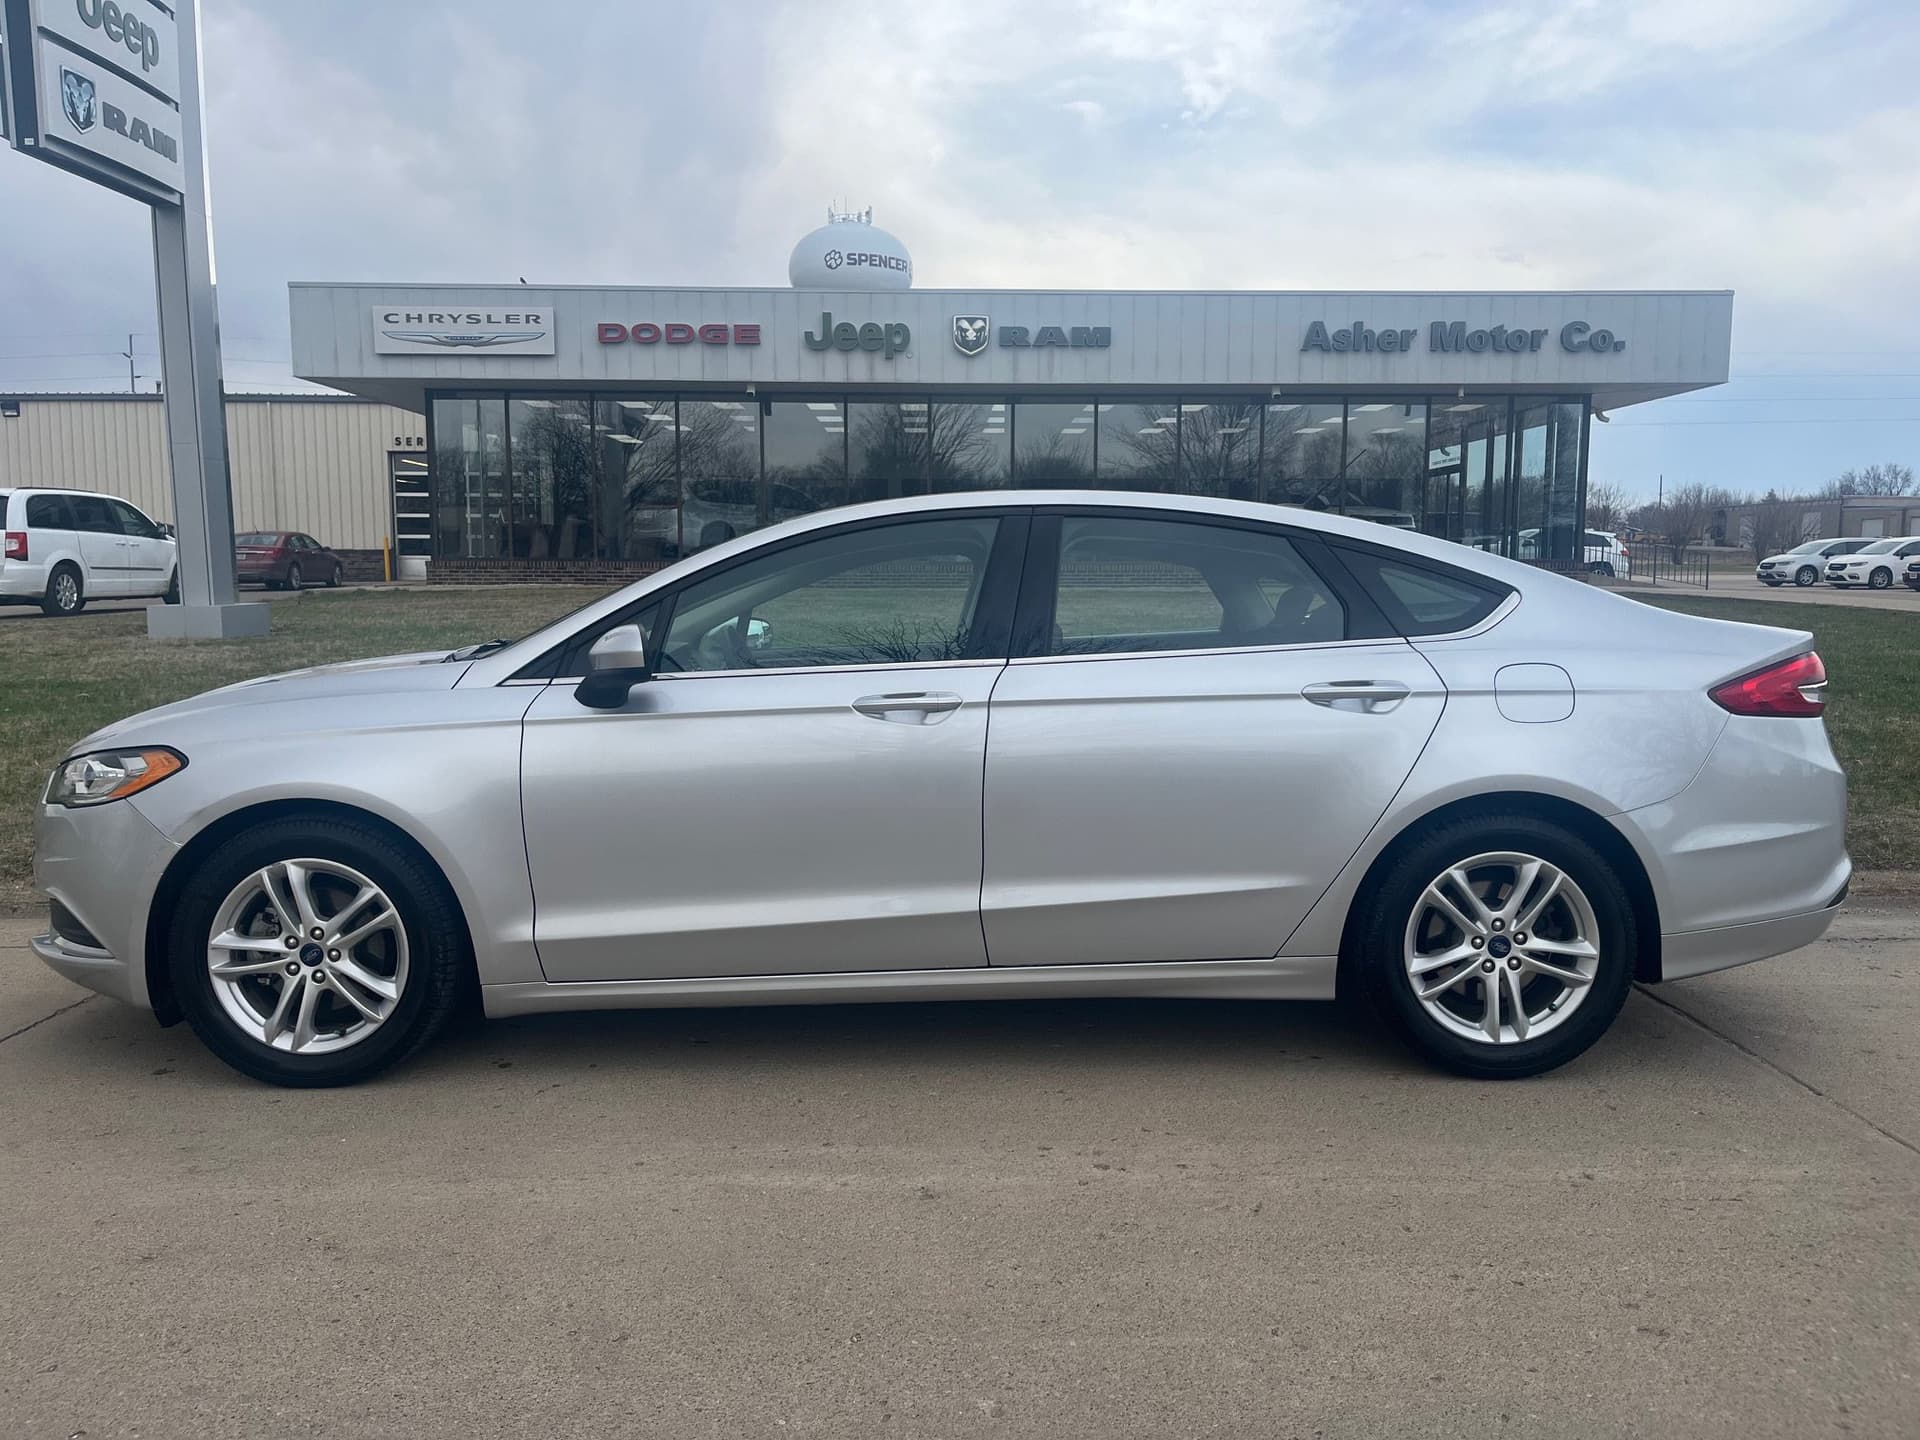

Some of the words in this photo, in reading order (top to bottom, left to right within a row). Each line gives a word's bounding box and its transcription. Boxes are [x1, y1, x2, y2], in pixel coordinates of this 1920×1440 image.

[102, 101, 178, 163] RAM
[846, 252, 908, 273] SPENCER
[383, 312, 542, 325] CHRYSLER
[597, 322, 761, 346] DODGE
[804, 311, 911, 360] Jeep
[999, 325, 1112, 348] RAM
[1301, 320, 1418, 352] Asher
[1429, 320, 1549, 352] Motor
[1560, 320, 1627, 353] Co.
